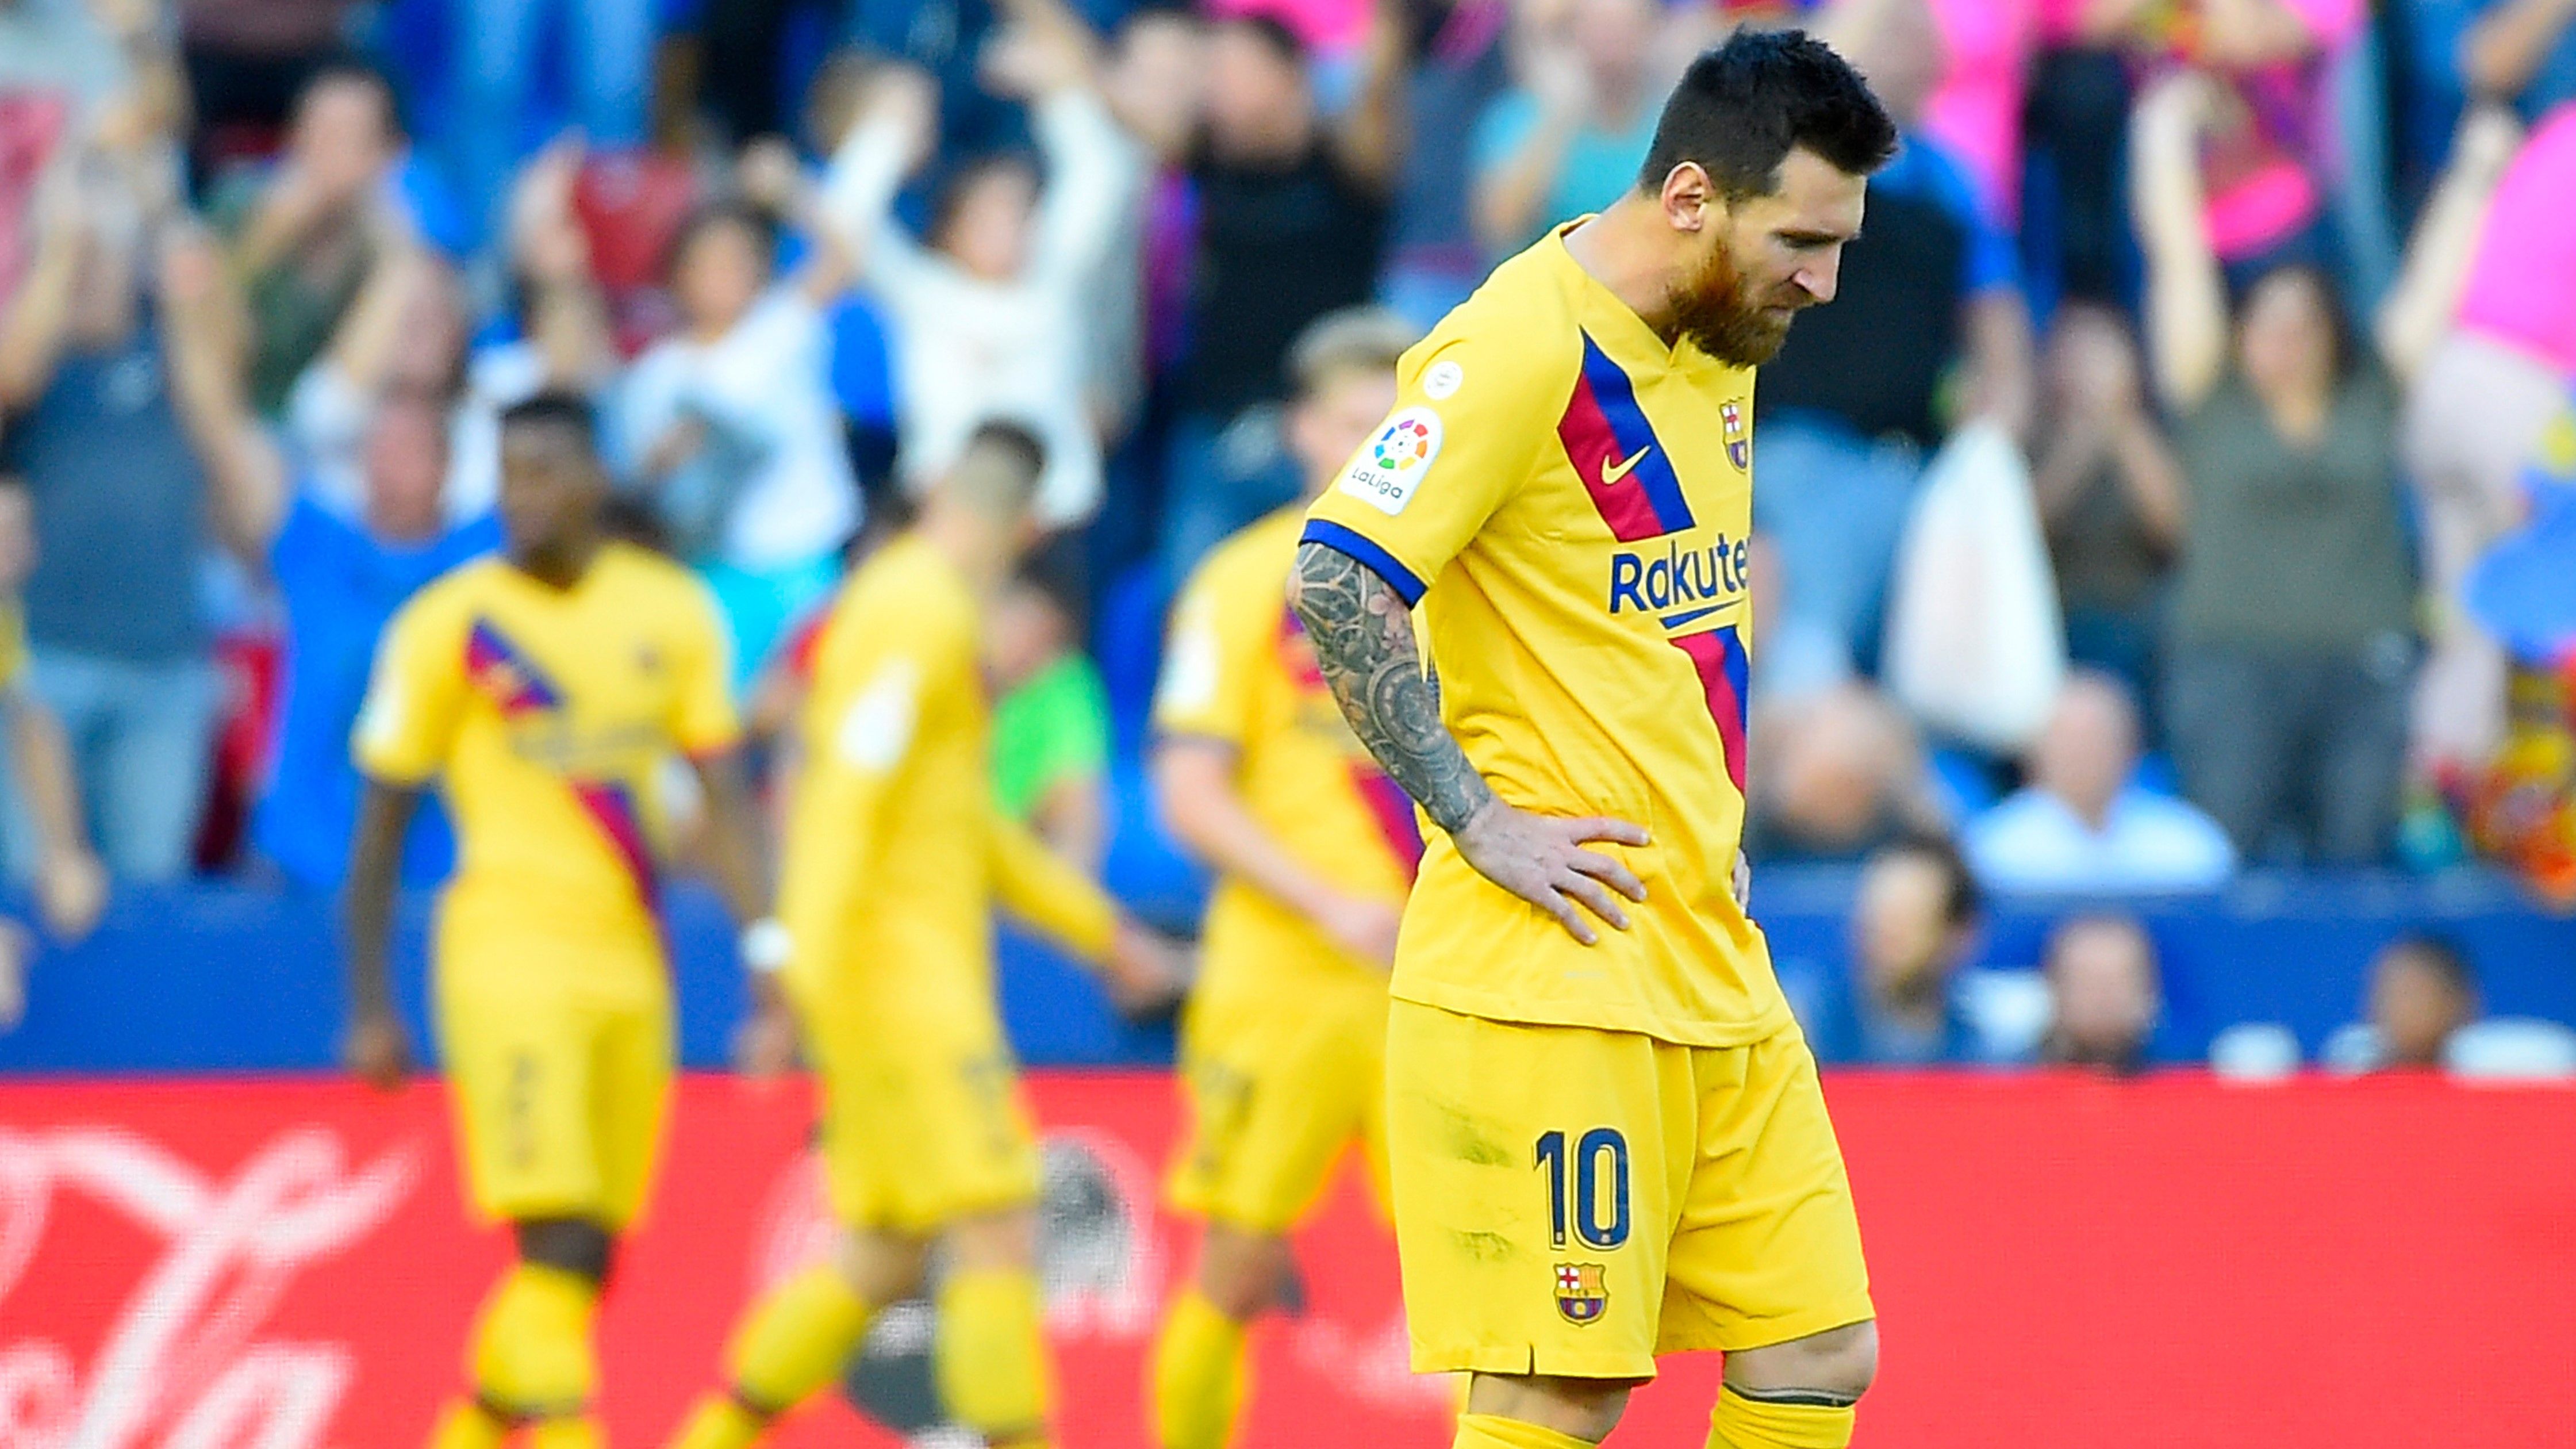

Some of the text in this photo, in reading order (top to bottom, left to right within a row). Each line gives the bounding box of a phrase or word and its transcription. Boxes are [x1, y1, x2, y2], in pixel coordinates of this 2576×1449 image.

[1352, 466, 1403, 499] LaLiga
[1610, 532, 1751, 614] Rakute
[1533, 1128, 1631, 1251] 10
